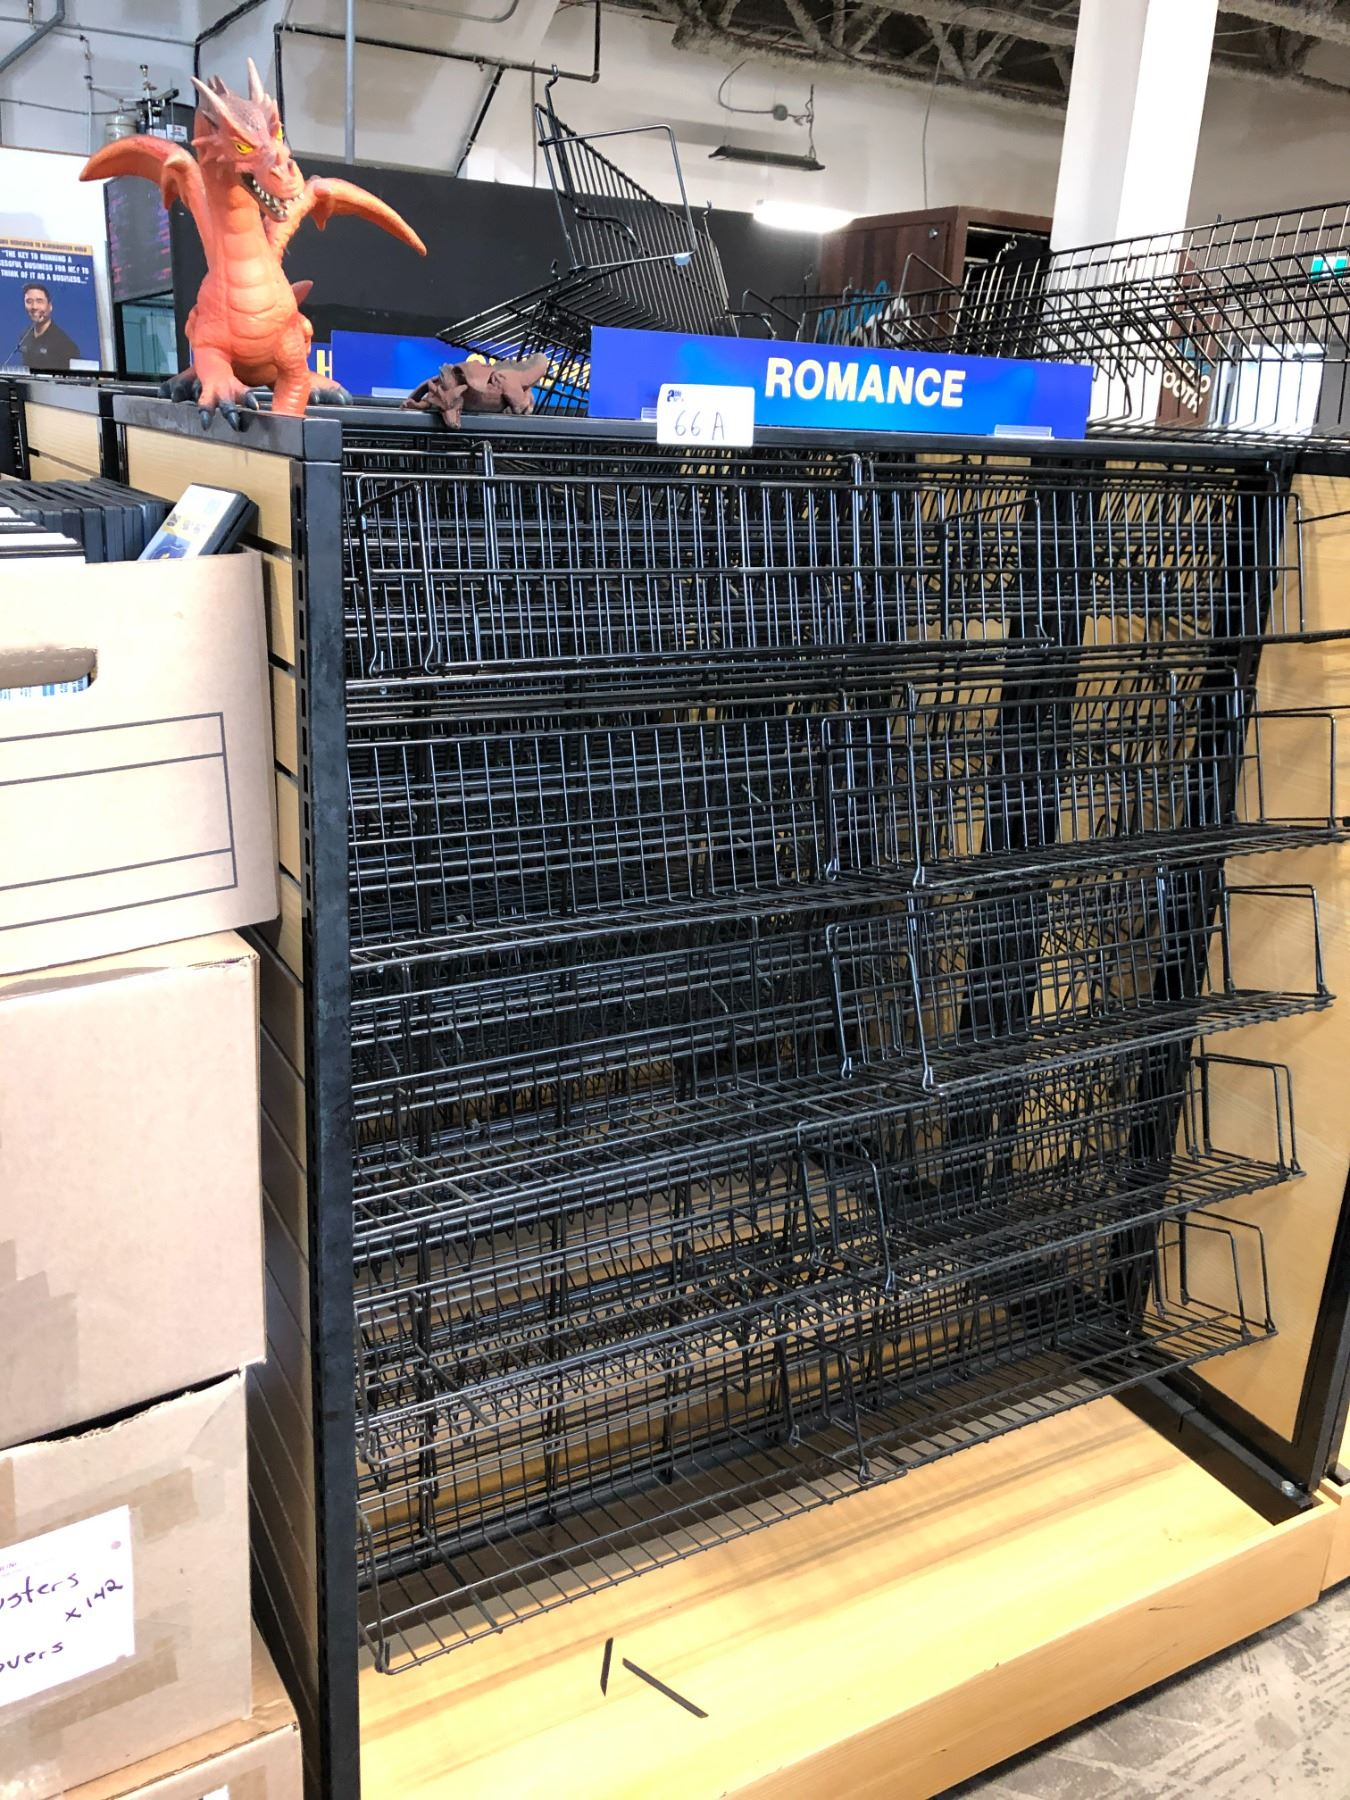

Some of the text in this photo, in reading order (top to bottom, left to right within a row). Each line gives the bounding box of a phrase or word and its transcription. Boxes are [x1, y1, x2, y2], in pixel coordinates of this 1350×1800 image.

[18, 251, 29, 259] KEY
[30, 252, 38, 260] TO
[40, 253, 67, 263] RUNNING
[0, 269, 19, 278] THINK
[20, 271, 28, 279] OF
[30, 272, 36, 280] IT
[37, 272, 45, 280] AS
[46, 273, 51, 281] A
[24, 261, 53, 271] BUSINESS
[55, 263, 66, 273] FOR
[81, 267, 89, 275] TO
[765, 357, 966, 408] ROMANCE
[674, 409, 725, 441] 66 A
